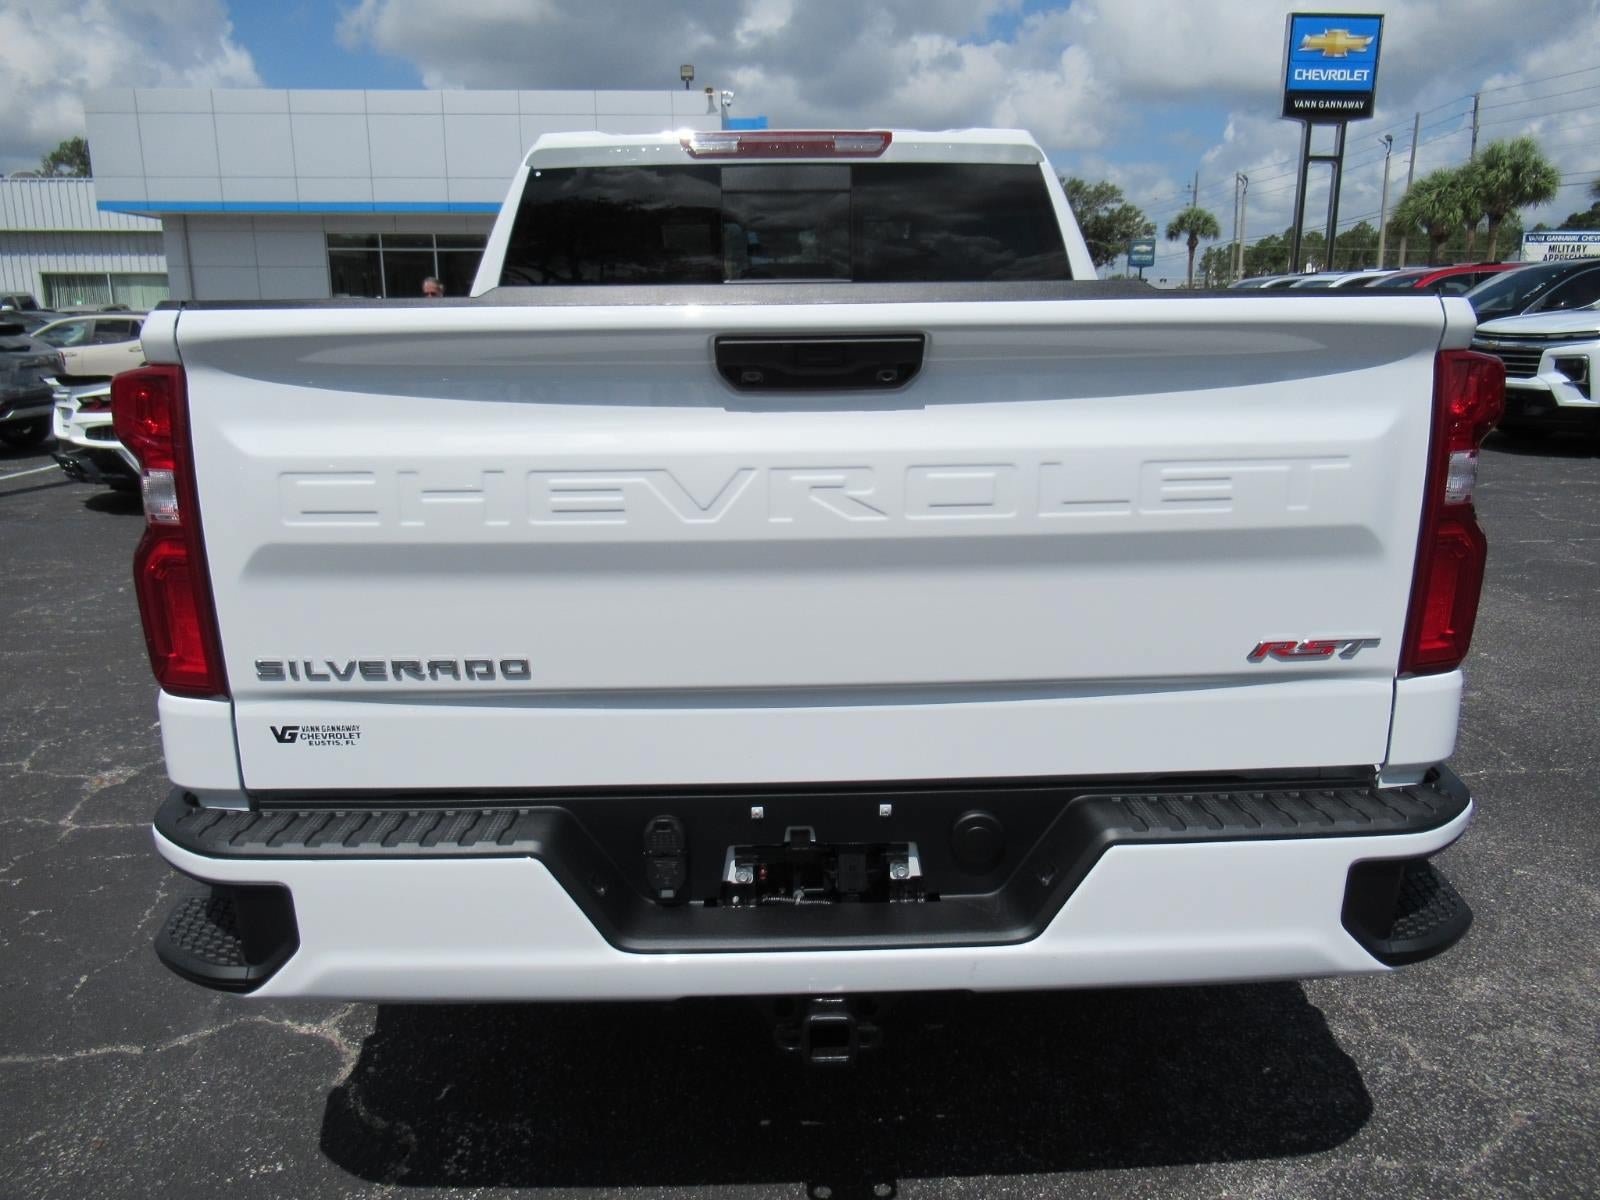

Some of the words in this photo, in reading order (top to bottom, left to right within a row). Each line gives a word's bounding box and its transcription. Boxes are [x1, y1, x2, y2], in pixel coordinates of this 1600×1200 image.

[1294, 68, 1370, 81] CHEVROLET
[1294, 99, 1317, 108] VANN
[1318, 100, 1365, 109] GANNAWAY
[1547, 244, 1588, 254] MILITARY
[278, 456, 1352, 530] CHEVROLET
[1246, 638, 1382, 663] RST
[254, 658, 532, 682] SILVERADO
[269, 725, 301, 744] VG
[321, 724, 361, 732] GANNAWAY
[300, 732, 362, 740] CHEVROLET
